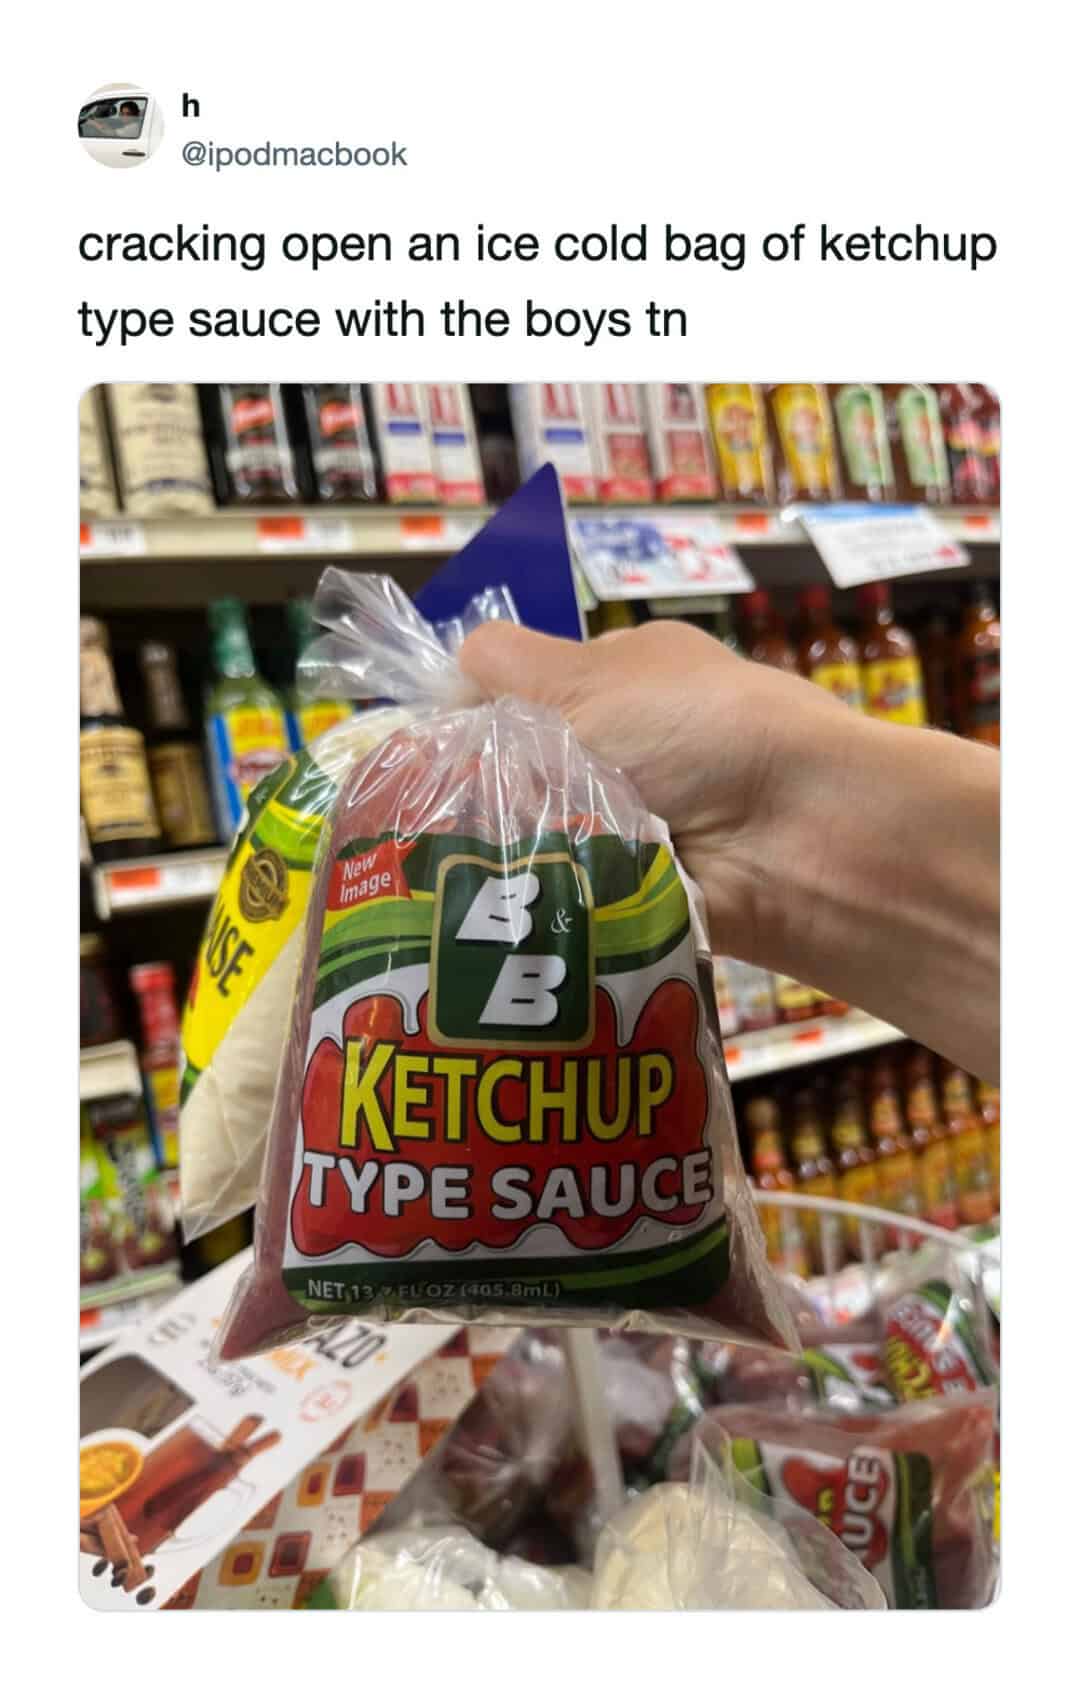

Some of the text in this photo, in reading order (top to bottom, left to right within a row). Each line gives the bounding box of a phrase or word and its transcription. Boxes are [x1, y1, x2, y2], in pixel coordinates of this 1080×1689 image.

[340, 871, 392, 903] Image
[343, 853, 378, 881] New
[455, 872, 574, 945] B &
[478, 954, 567, 1026] B
[340, 1040, 674, 1151] KETCHUP
[302, 1149, 713, 1220] TYPE SAUCE
[307, 1279, 345, 1300] NET
[426, 1281, 458, 1298] OZ
